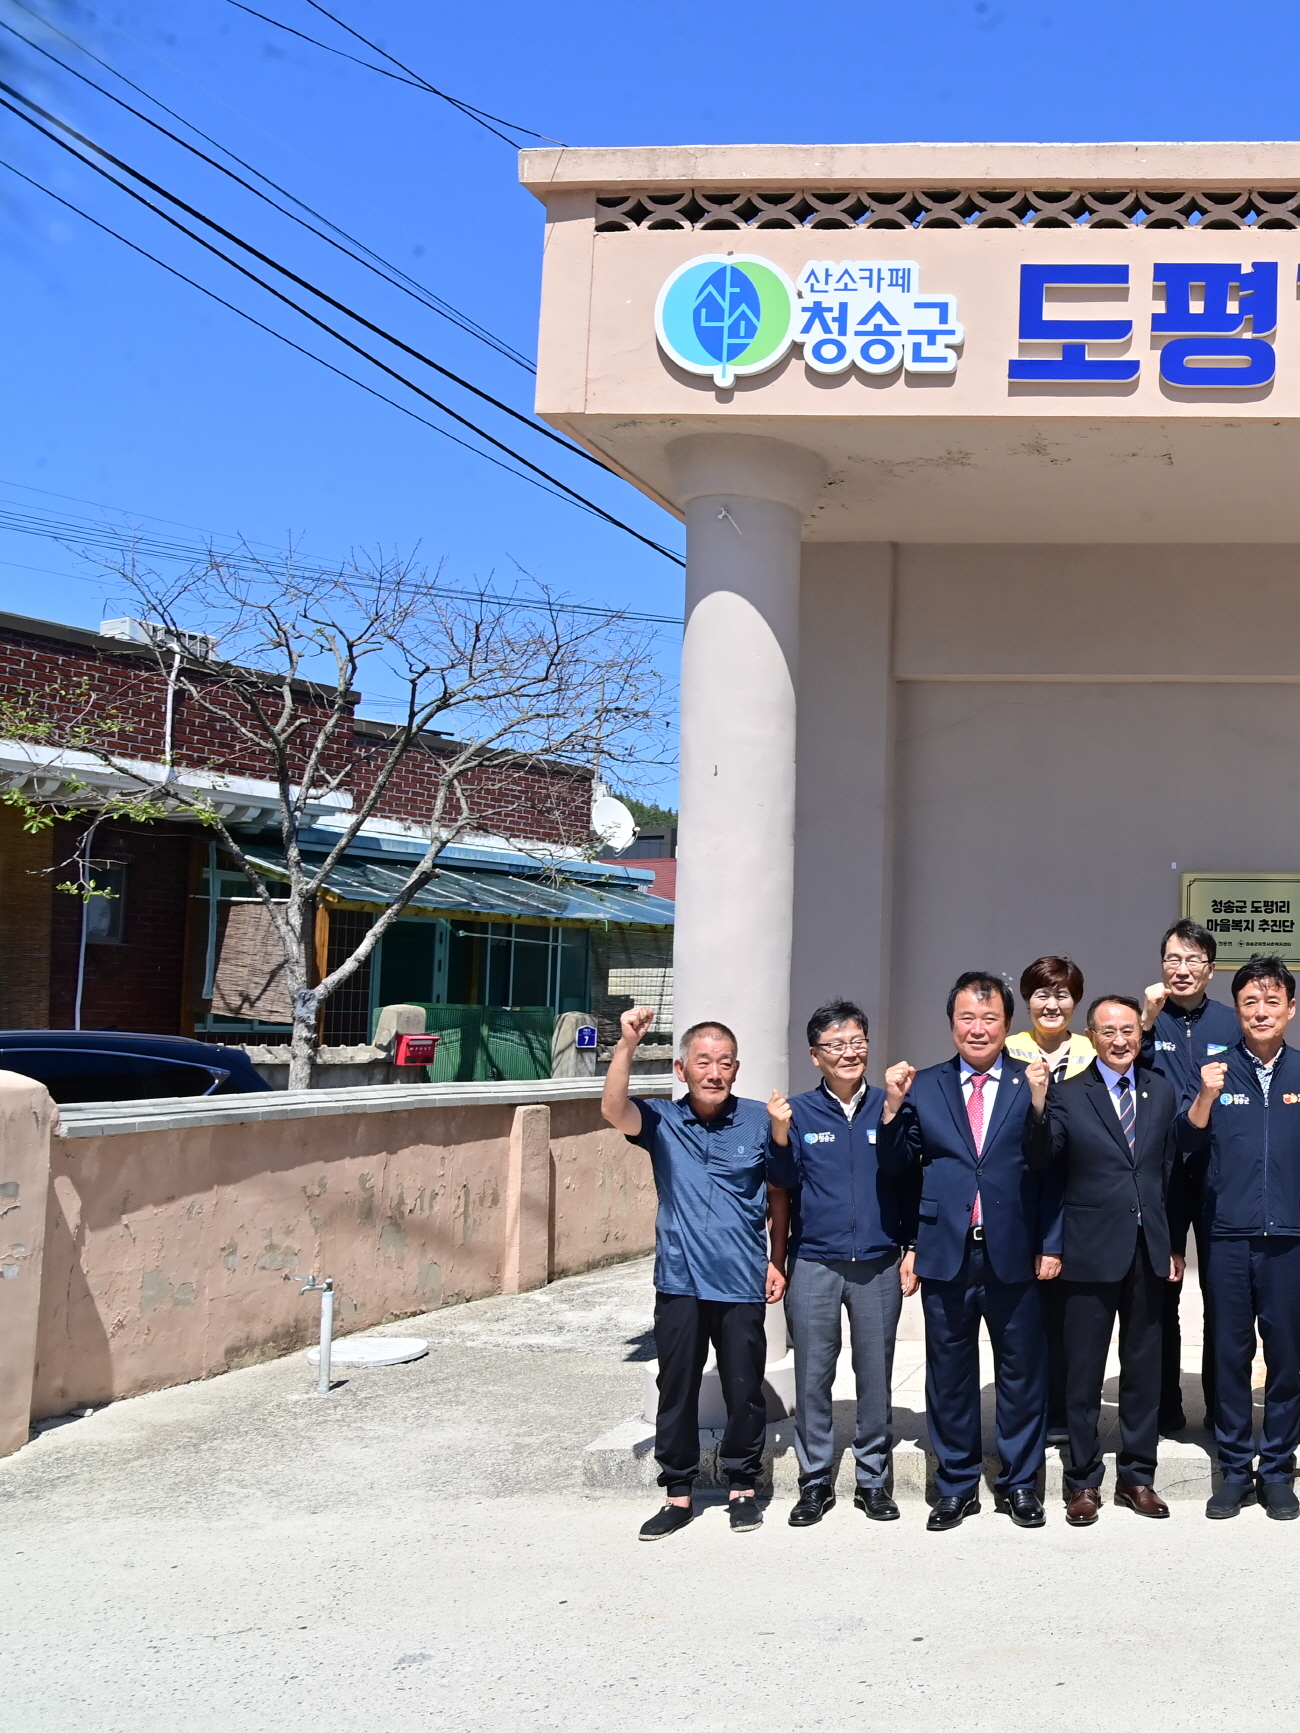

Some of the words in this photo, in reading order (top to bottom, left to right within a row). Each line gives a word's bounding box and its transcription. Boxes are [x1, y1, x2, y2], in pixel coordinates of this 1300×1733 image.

[804, 266, 912, 295] 산소카페
[800, 300, 960, 365] 청송군
[1211, 899, 1247, 914] 청송군
[1250, 900, 1290, 914] 도평1리
[1206, 919, 1254, 933] 마을복지
[1258, 919, 1294, 933] 추진단
[584, 1036, 589, 1045] 7
